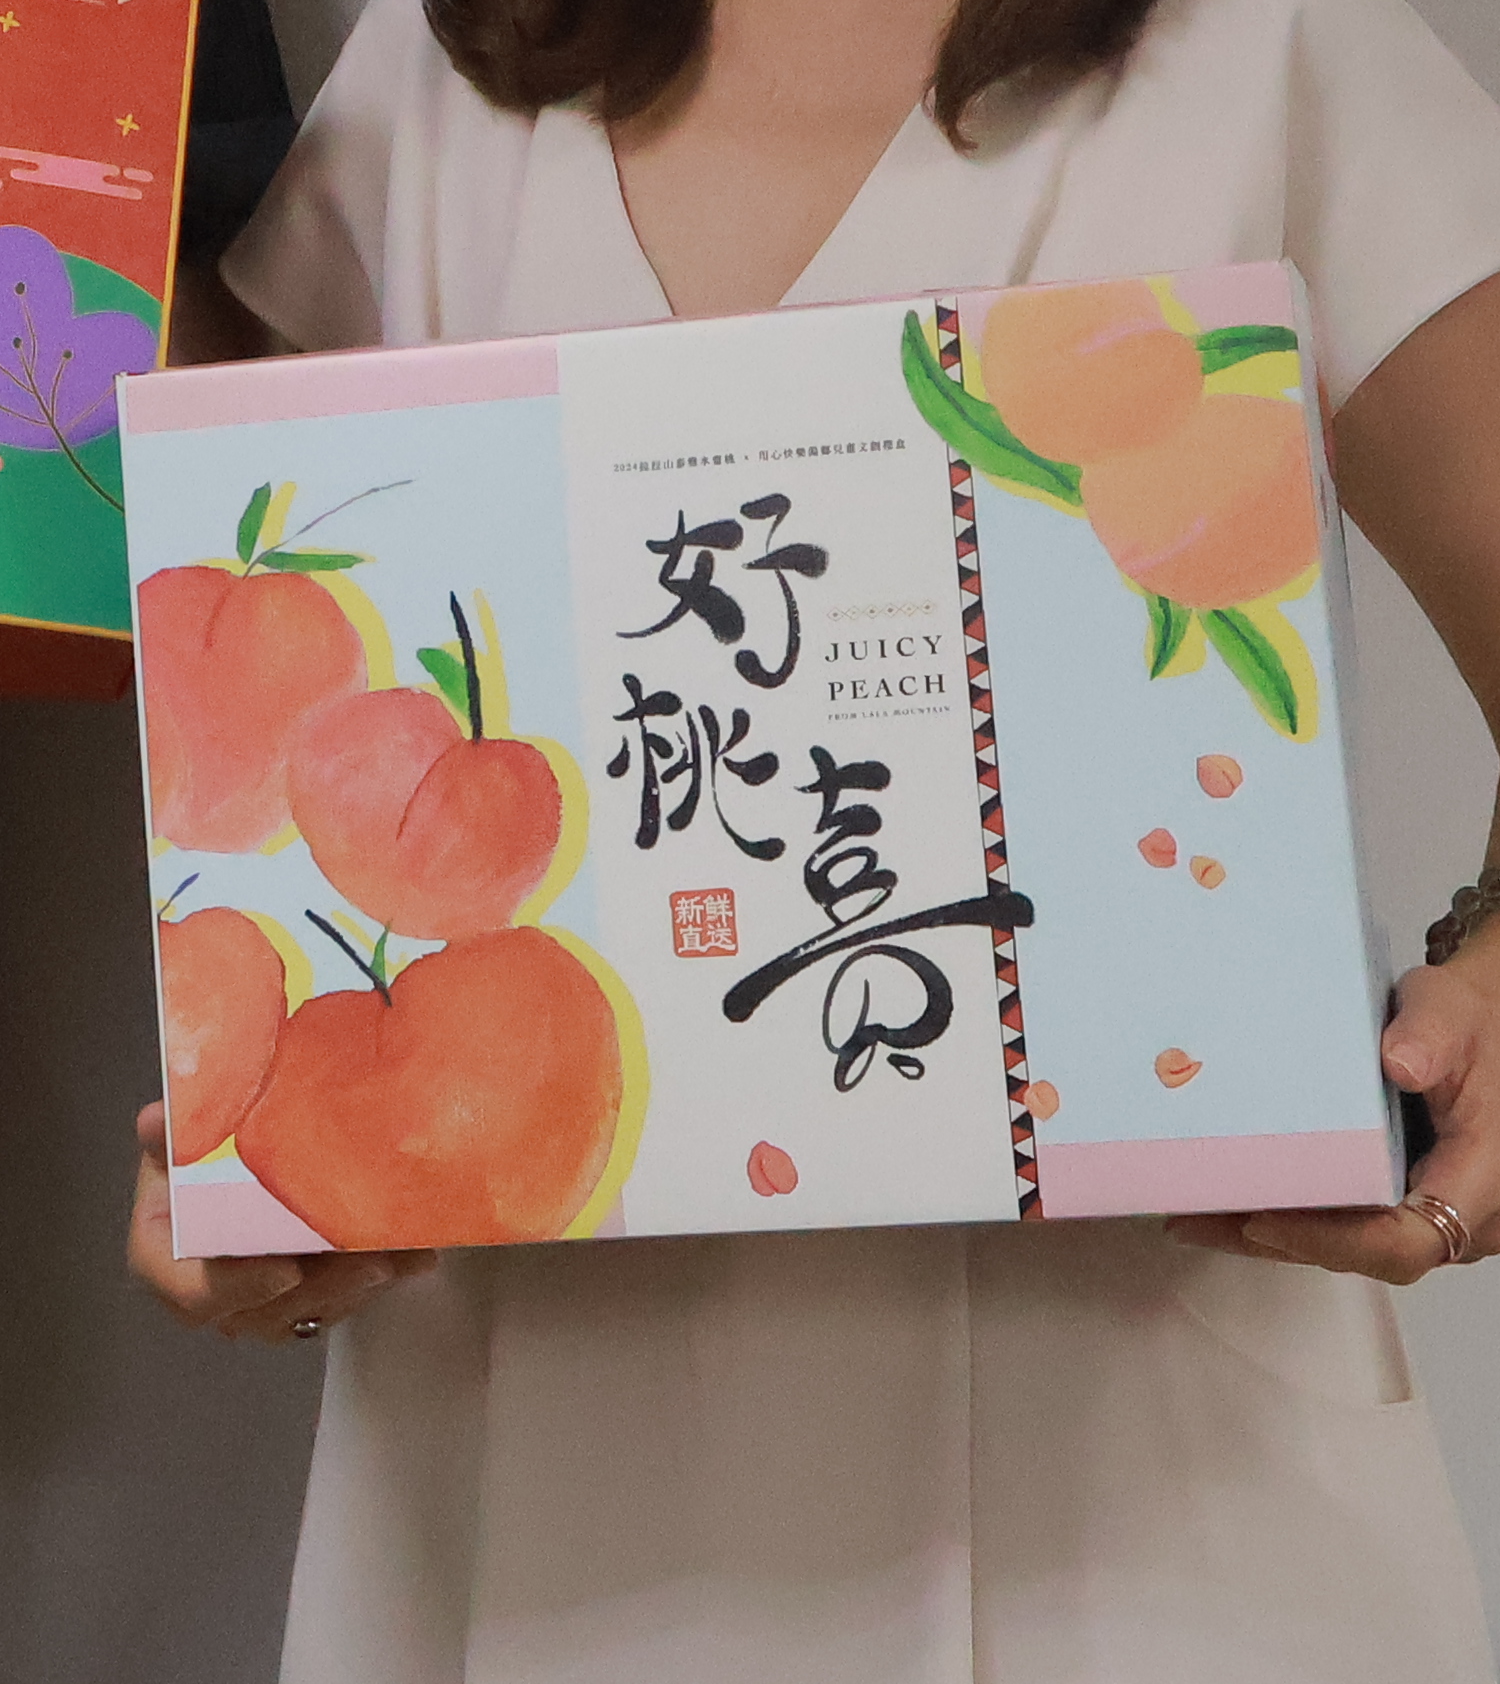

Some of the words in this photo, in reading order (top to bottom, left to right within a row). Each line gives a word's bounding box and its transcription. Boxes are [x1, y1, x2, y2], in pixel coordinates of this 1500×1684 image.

[824, 635, 943, 663] JUICY
[828, 673, 946, 701] PEACH
[674, 893, 733, 927] 新鮮
[677, 923, 736, 953] 直送
